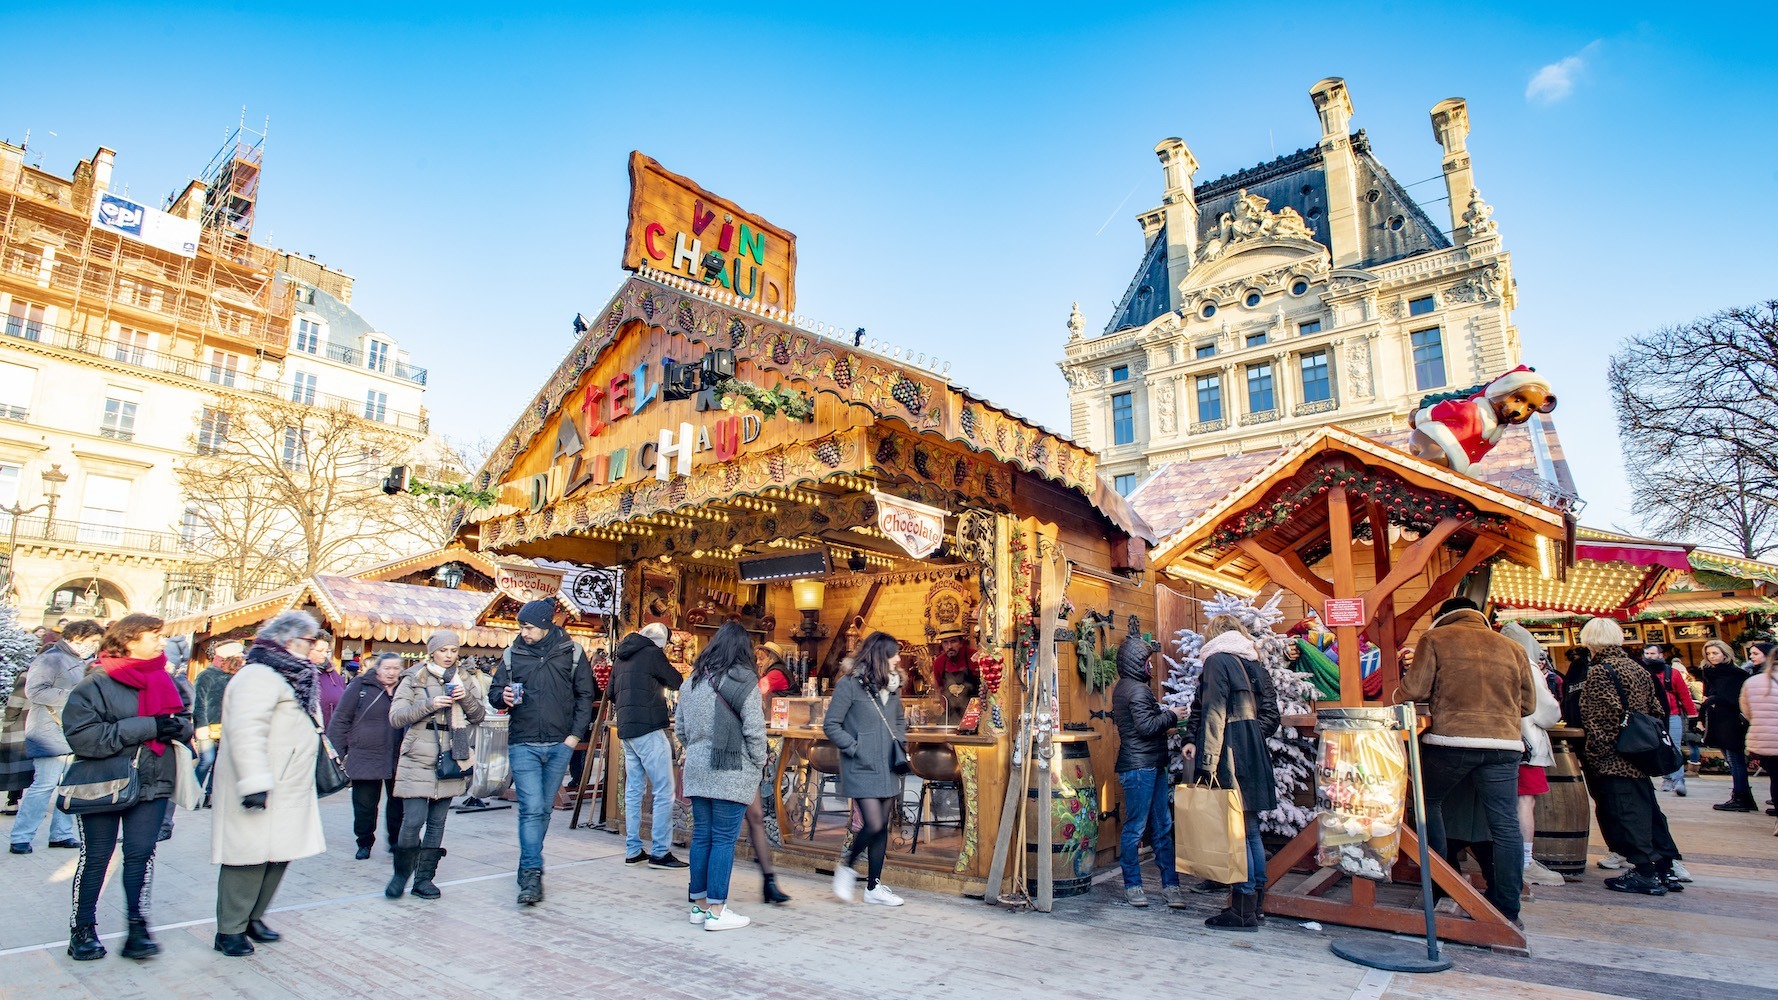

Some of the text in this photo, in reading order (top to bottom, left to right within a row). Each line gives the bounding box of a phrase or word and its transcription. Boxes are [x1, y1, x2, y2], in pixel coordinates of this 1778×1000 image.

[531, 465, 562, 514] DU
[640, 414, 762, 482] CHAUD
[884, 514, 942, 544] Chocolate
[501, 576, 559, 595] Chocolate
[1679, 626, 1711, 637] Aligot
